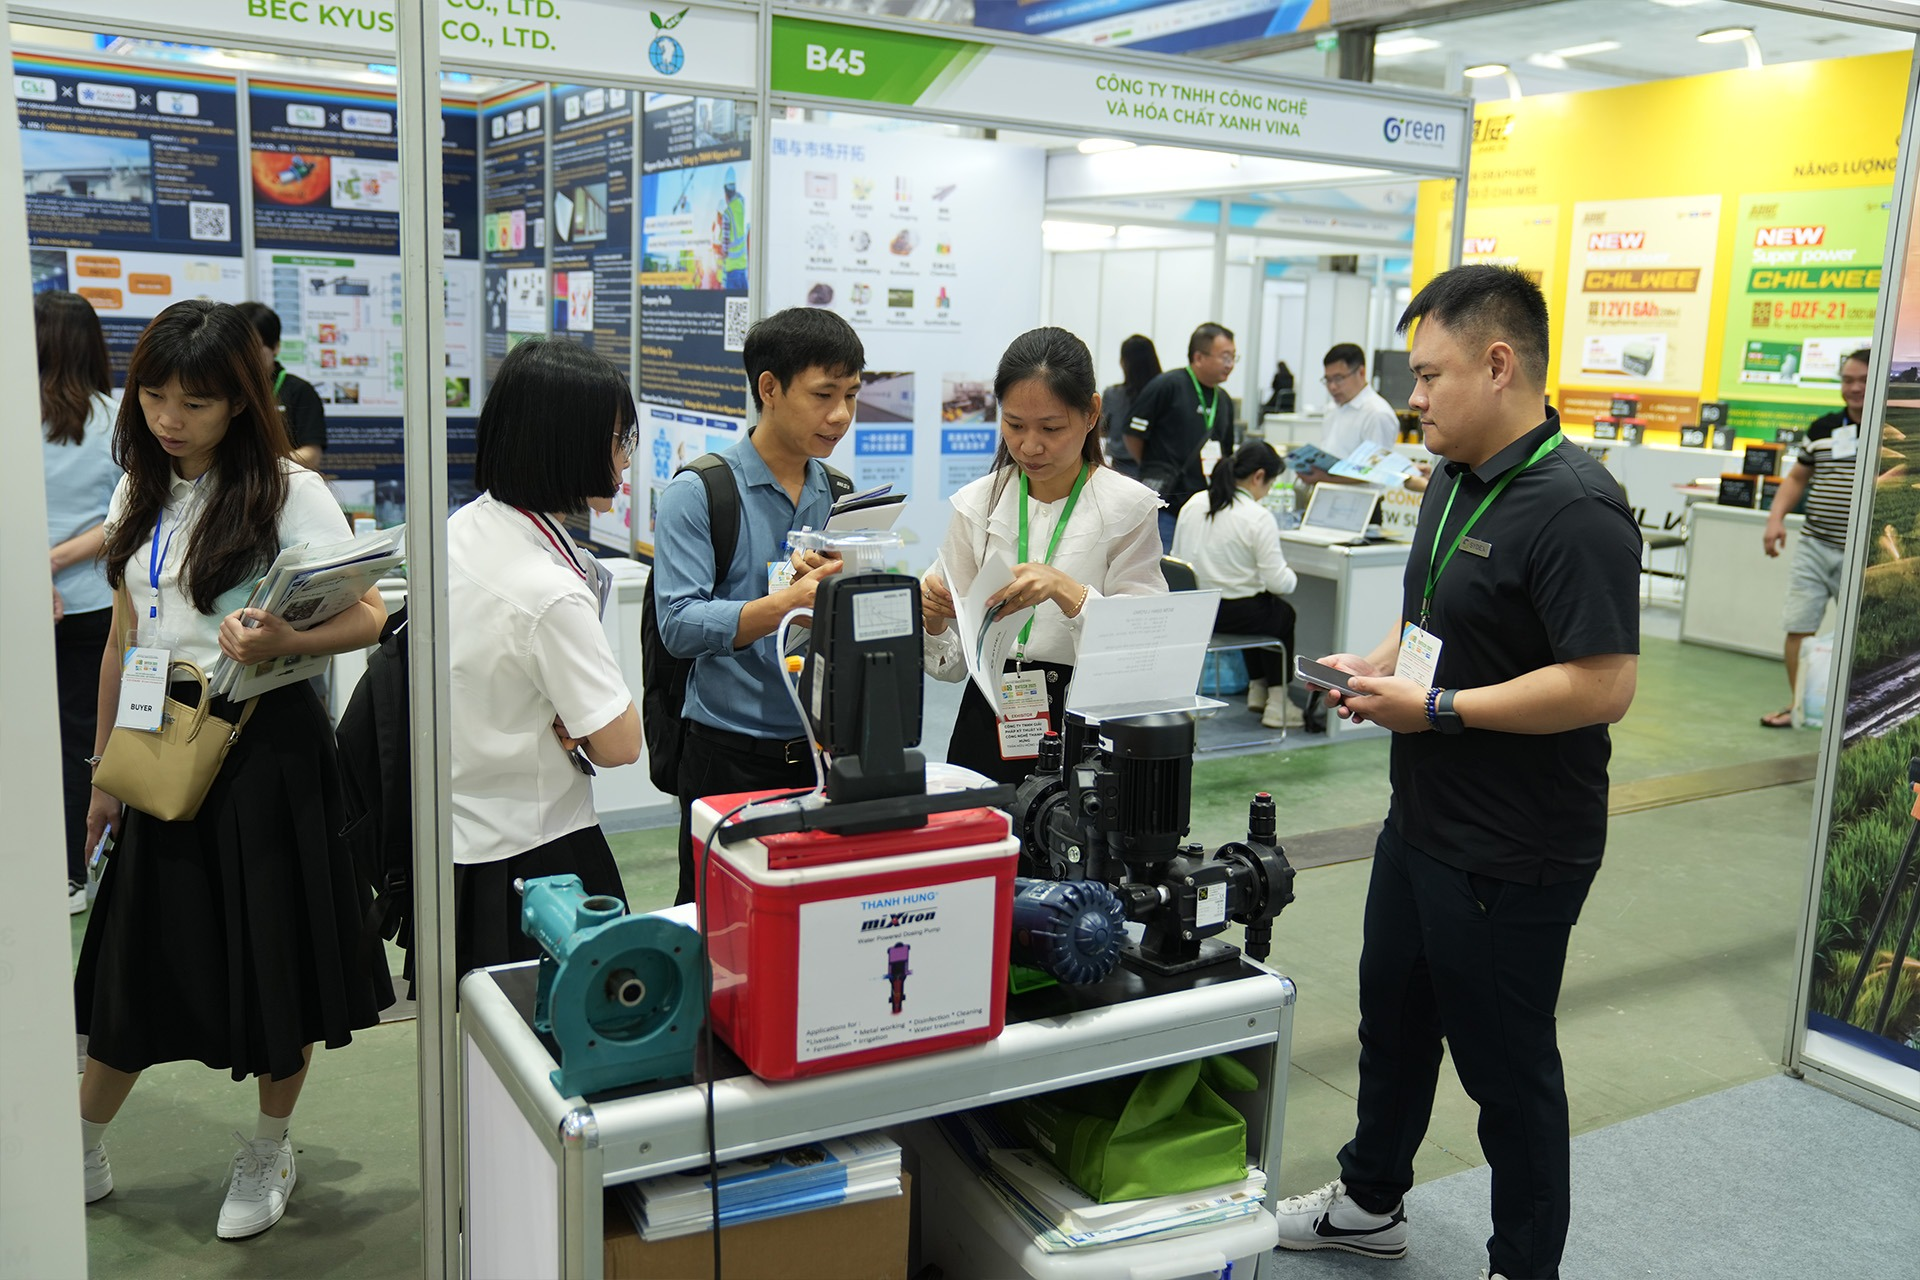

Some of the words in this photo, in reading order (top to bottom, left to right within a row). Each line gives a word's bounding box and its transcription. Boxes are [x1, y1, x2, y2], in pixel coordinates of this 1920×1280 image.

[248, 0, 308, 22] BEC
[319, 5, 395, 32] KYUS
[441, 20, 493, 48] CO.,
[503, 26, 556, 50] LTD.
[806, 44, 866, 76] B45
[1096, 74, 1143, 95] CÔNG
[1148, 82, 1166, 97] TY
[1172, 85, 1214, 104] TNHH
[1219, 88, 1262, 110] CÔNG
[1268, 98, 1307, 120] NGHỆ
[1106, 98, 1128, 117] VÀ
[1134, 100, 1168, 122] HÓA
[1173, 107, 1214, 126] CHẤT
[1219, 114, 1261, 133] XANH
[1266, 119, 1301, 137] VINA
[1384, 117, 1444, 142] Green
[1463, 237, 1497, 253] EW
[1589, 233, 1644, 249] NEW
[1756, 227, 1824, 246] NEW
[1752, 247, 1798, 265] Super
[1802, 248, 1856, 265] power
[1585, 271, 1696, 289] CHILWEE
[1752, 269, 1882, 289] CHILWEE
[130, 703, 153, 712] BUYER
[860, 896, 900, 911] THANH
[903, 891, 936, 904] HUNG
[858, 936, 875, 945] Water
[876, 932, 902, 942] Powered
[903, 929, 923, 939] Dosing
[924, 926, 941, 936] Pump
[806, 1023, 847, 1037] Applications
[847, 1021, 857, 1029] for
[809, 1033, 840, 1046] Livestock
[859, 1027, 879, 1036] Metal
[880, 1021, 905, 1033] working
[913, 1013, 950, 1026] Disinfection
[956, 1007, 983, 1018] Cleaning
[813, 1040, 852, 1054] Fertilization
[858, 1033, 888, 1045] Irrigation
[913, 1024, 933, 1034] Water
[934, 1018, 966, 1031] treatment
